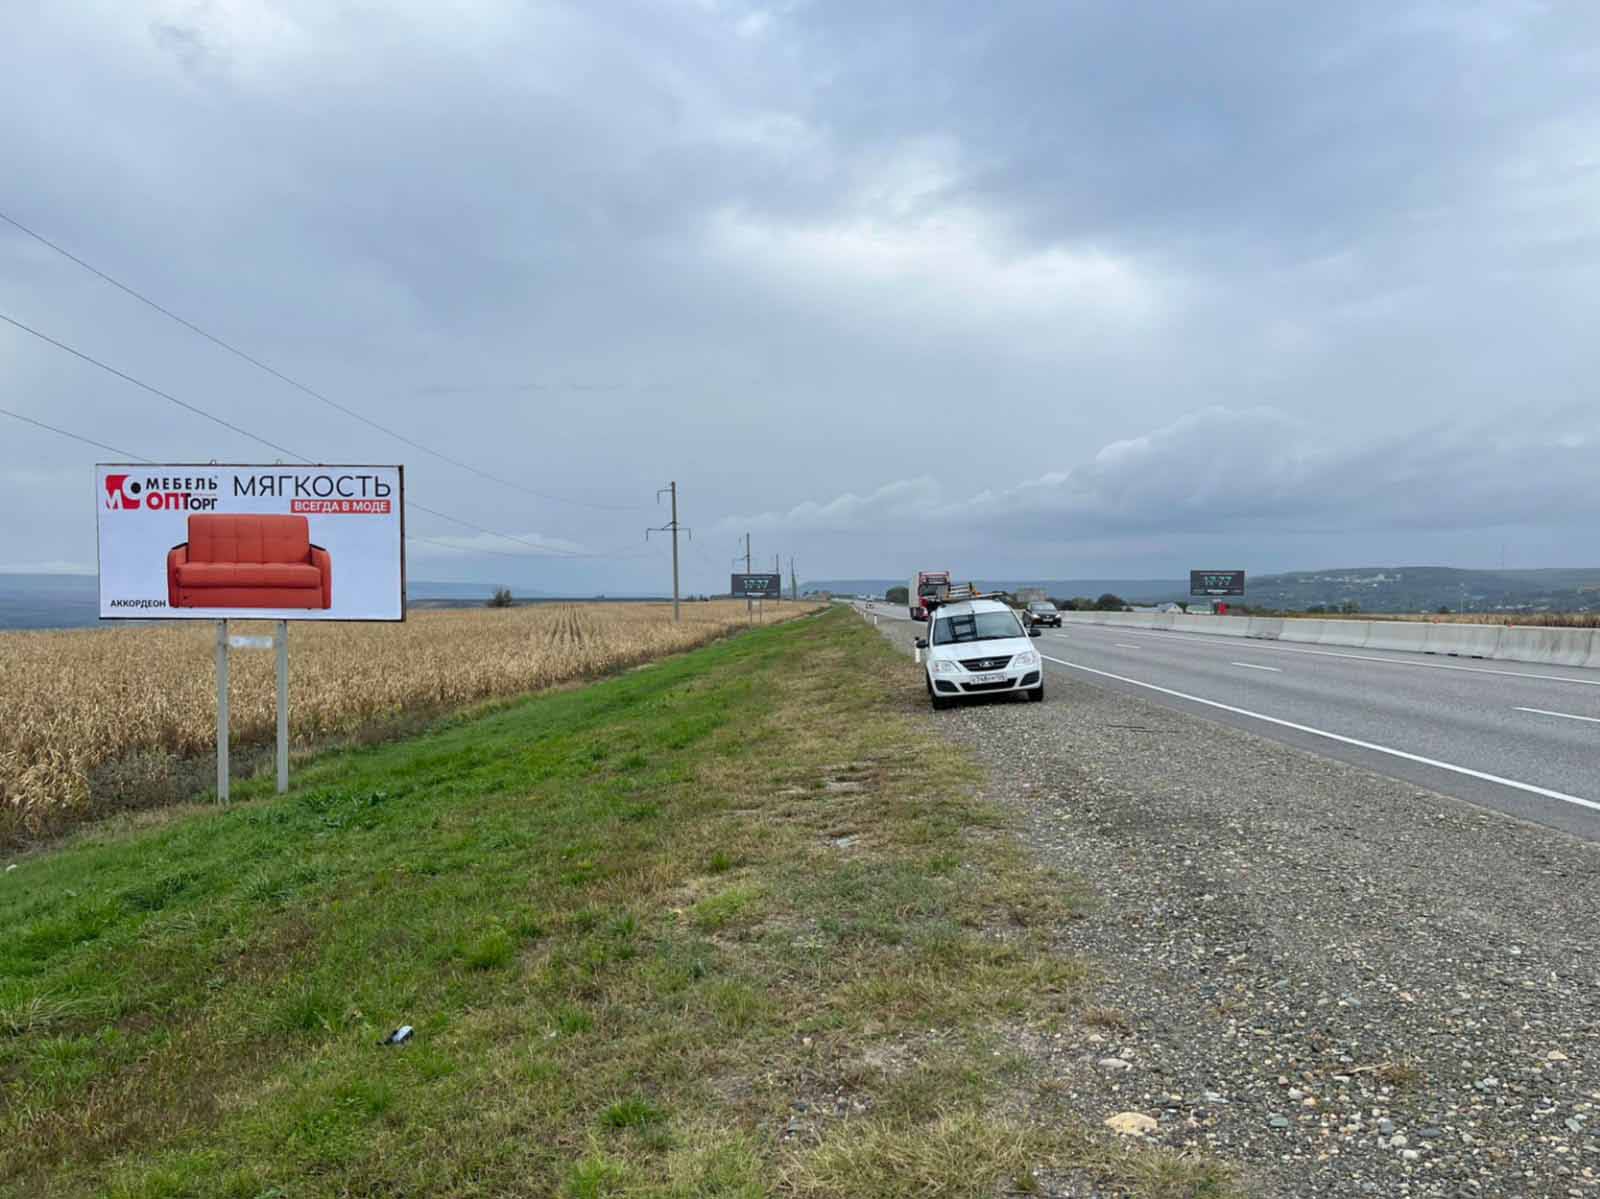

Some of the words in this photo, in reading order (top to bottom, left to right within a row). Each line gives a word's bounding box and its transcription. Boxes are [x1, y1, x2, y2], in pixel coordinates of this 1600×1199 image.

[146, 478, 218, 490] МЕБЕЛЬ
[234, 475, 391, 497] МЯГКОСТЬ
[294, 501, 339, 512] ВСЕГДА
[342, 501, 350, 511] В
[353, 501, 387, 512] МОДЕ
[110, 599, 167, 608] АККОРДЕОН
